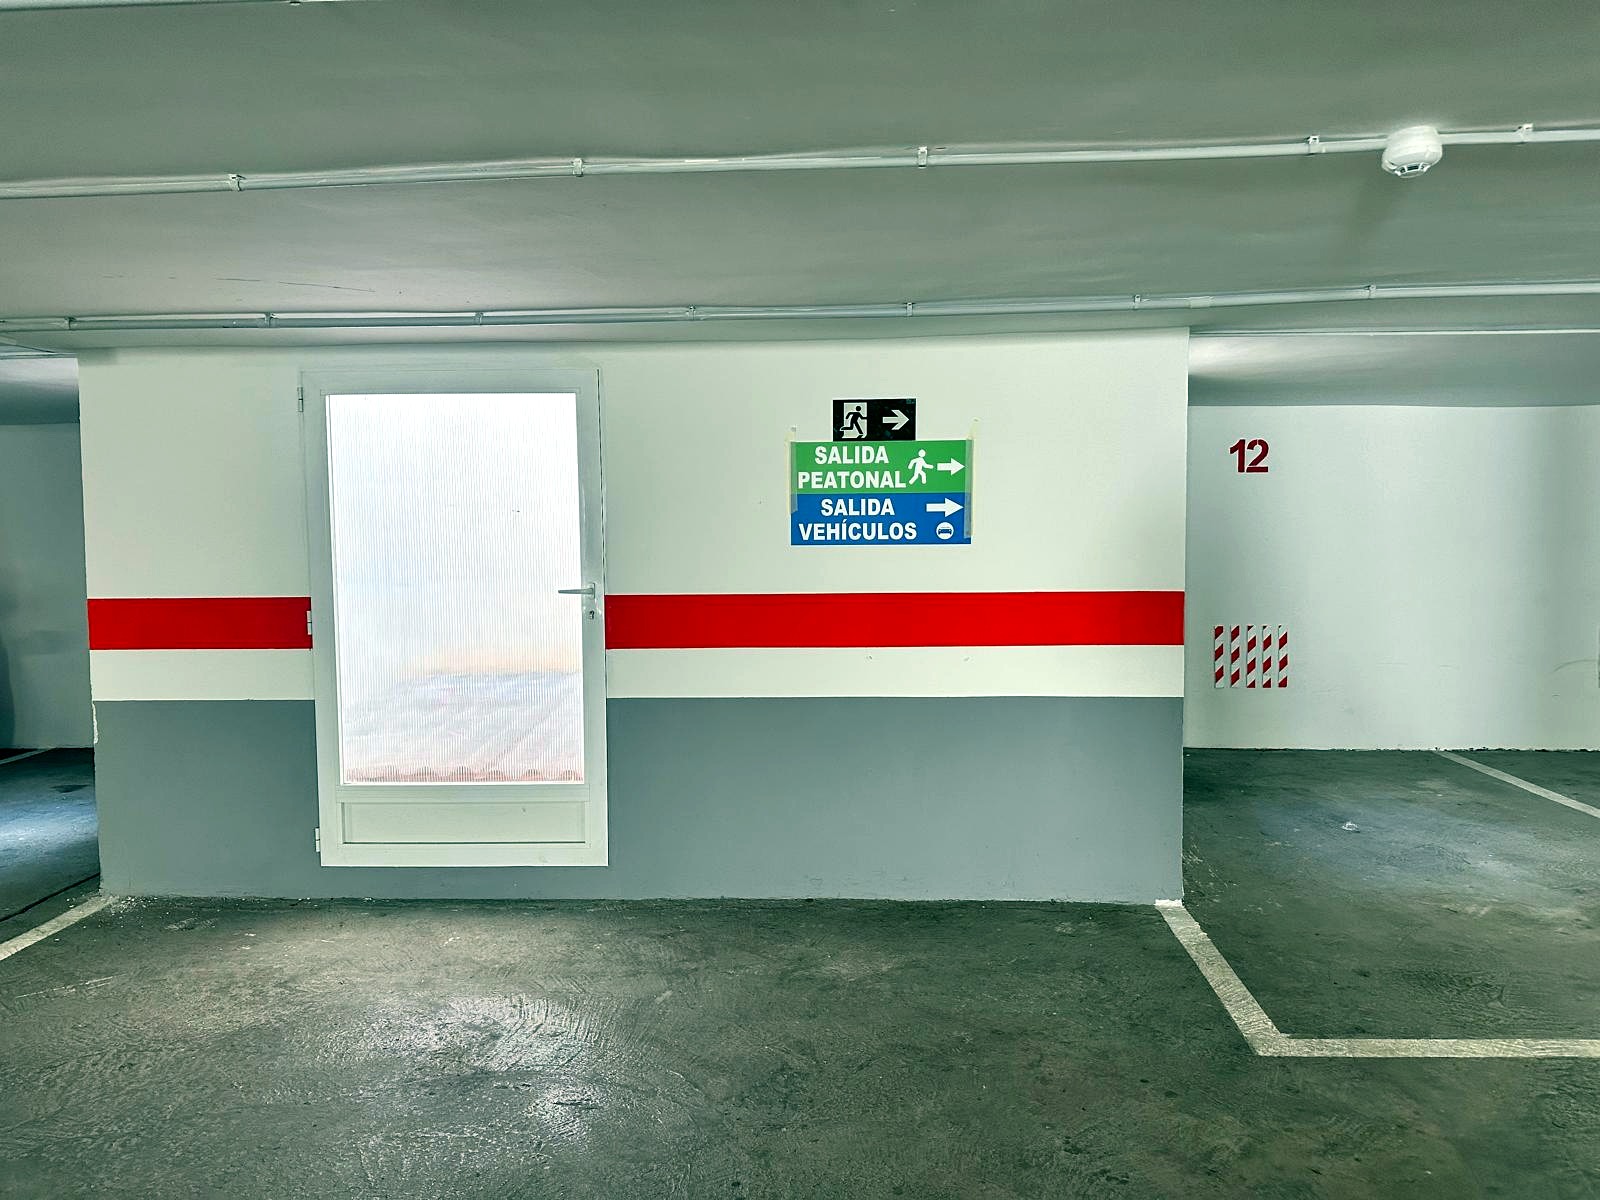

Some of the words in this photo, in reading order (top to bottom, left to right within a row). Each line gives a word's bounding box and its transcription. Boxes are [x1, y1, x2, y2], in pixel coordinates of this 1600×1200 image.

[814, 445, 889, 465] SALIDA
[1229, 439, 1269, 473] 12
[798, 471, 907, 489] PEATONAL
[820, 498, 895, 516] SALIDA
[798, 518, 917, 541] VEHÍCULOS
